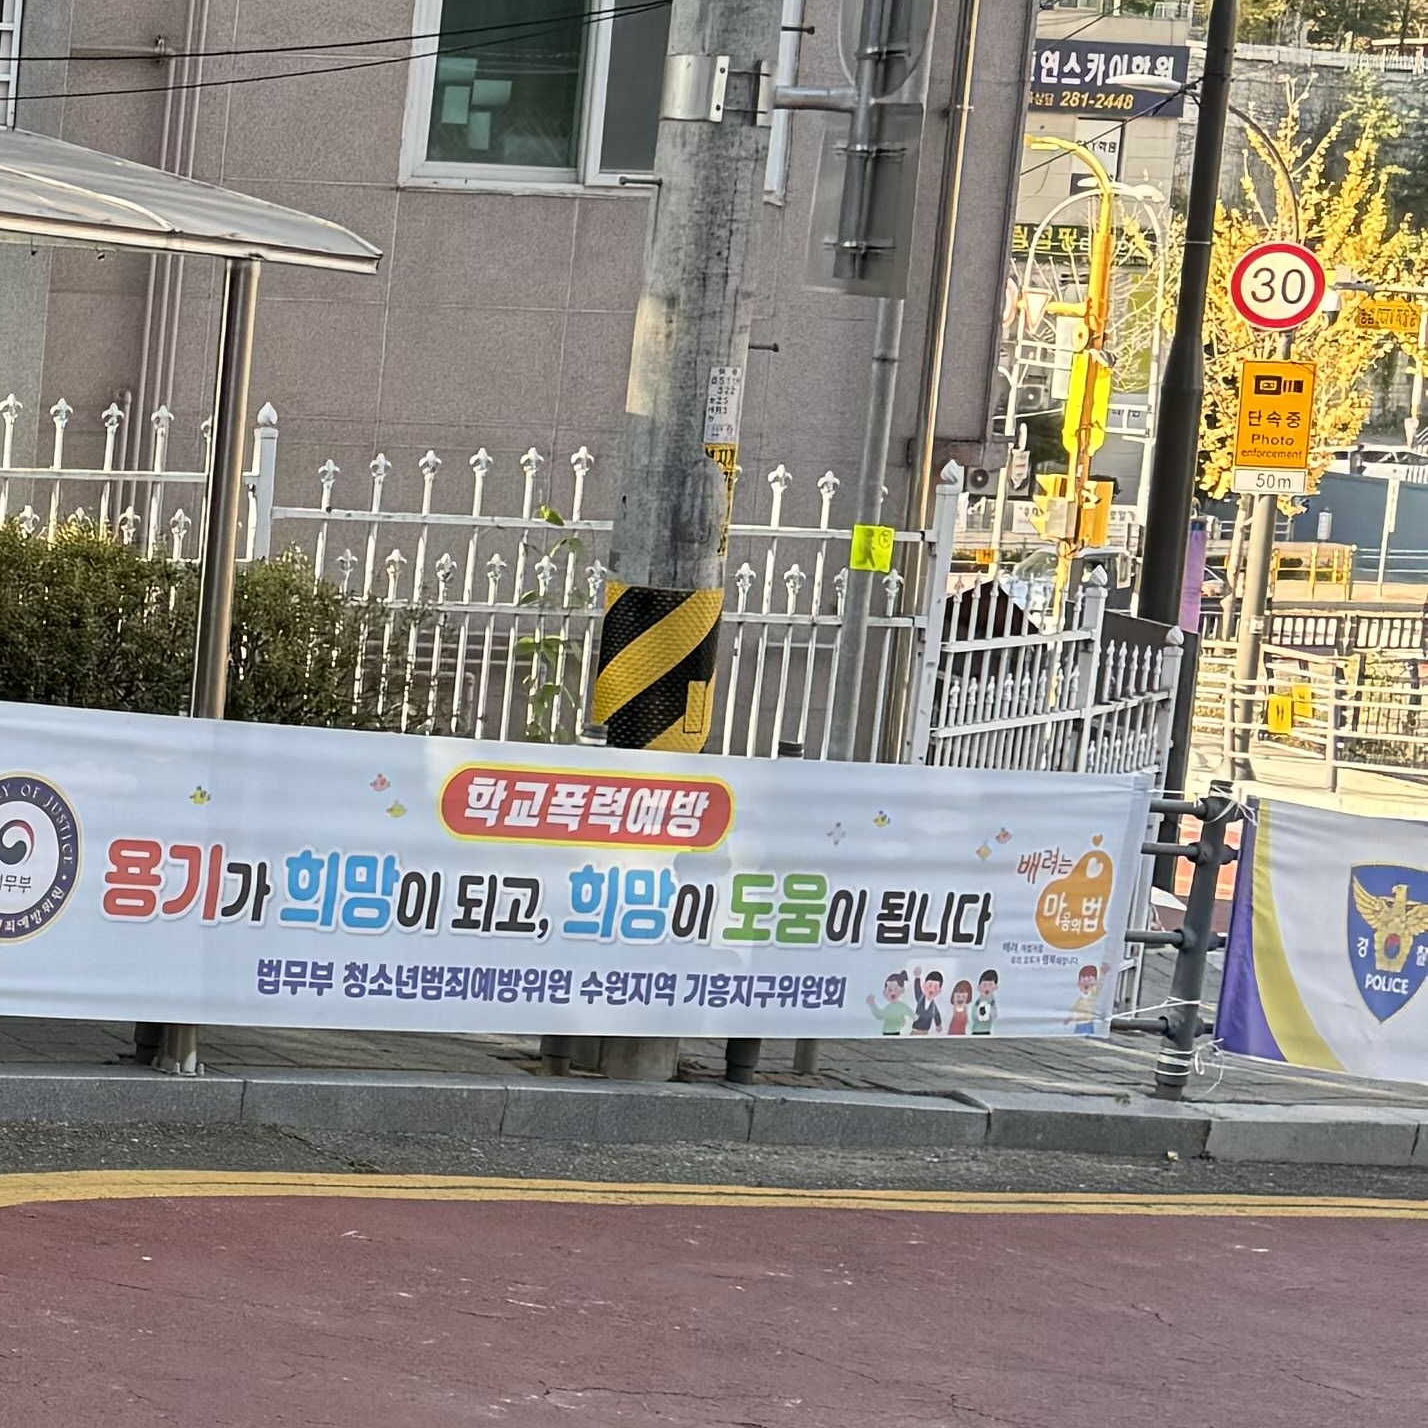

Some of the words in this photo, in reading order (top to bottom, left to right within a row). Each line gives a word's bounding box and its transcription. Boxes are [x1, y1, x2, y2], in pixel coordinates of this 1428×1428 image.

[1060, 91, 1134, 109] 281-2448
[1251, 267, 1306, 304] 30
[1248, 410, 1301, 428] 단속중
[1241, 448, 1303, 460] enforcement
[1251, 433, 1294, 446] Photo
[1255, 473, 1292, 489] 50m
[464, 776, 710, 838] 학교폭력예방
[20, 783, 41, 799] OF
[43, 795, 74, 865] JUSTICE
[1016, 847, 1073, 884] 배려는
[102, 838, 271, 922] 용기가
[279, 848, 440, 931] 희망이
[451, 873, 549, 939] 되고,
[563, 864, 715, 940] 희망이
[722, 872, 868, 944] 도움이
[875, 889, 992, 945] 됩니다
[256, 958, 335, 996] 법무부
[342, 961, 574, 1005] 청소년범죄예방위원
[579, 970, 677, 1008] 수원지역
[682, 973, 848, 1010] 기흥지구위원회
[1364, 973, 1409, 994] POLICE
